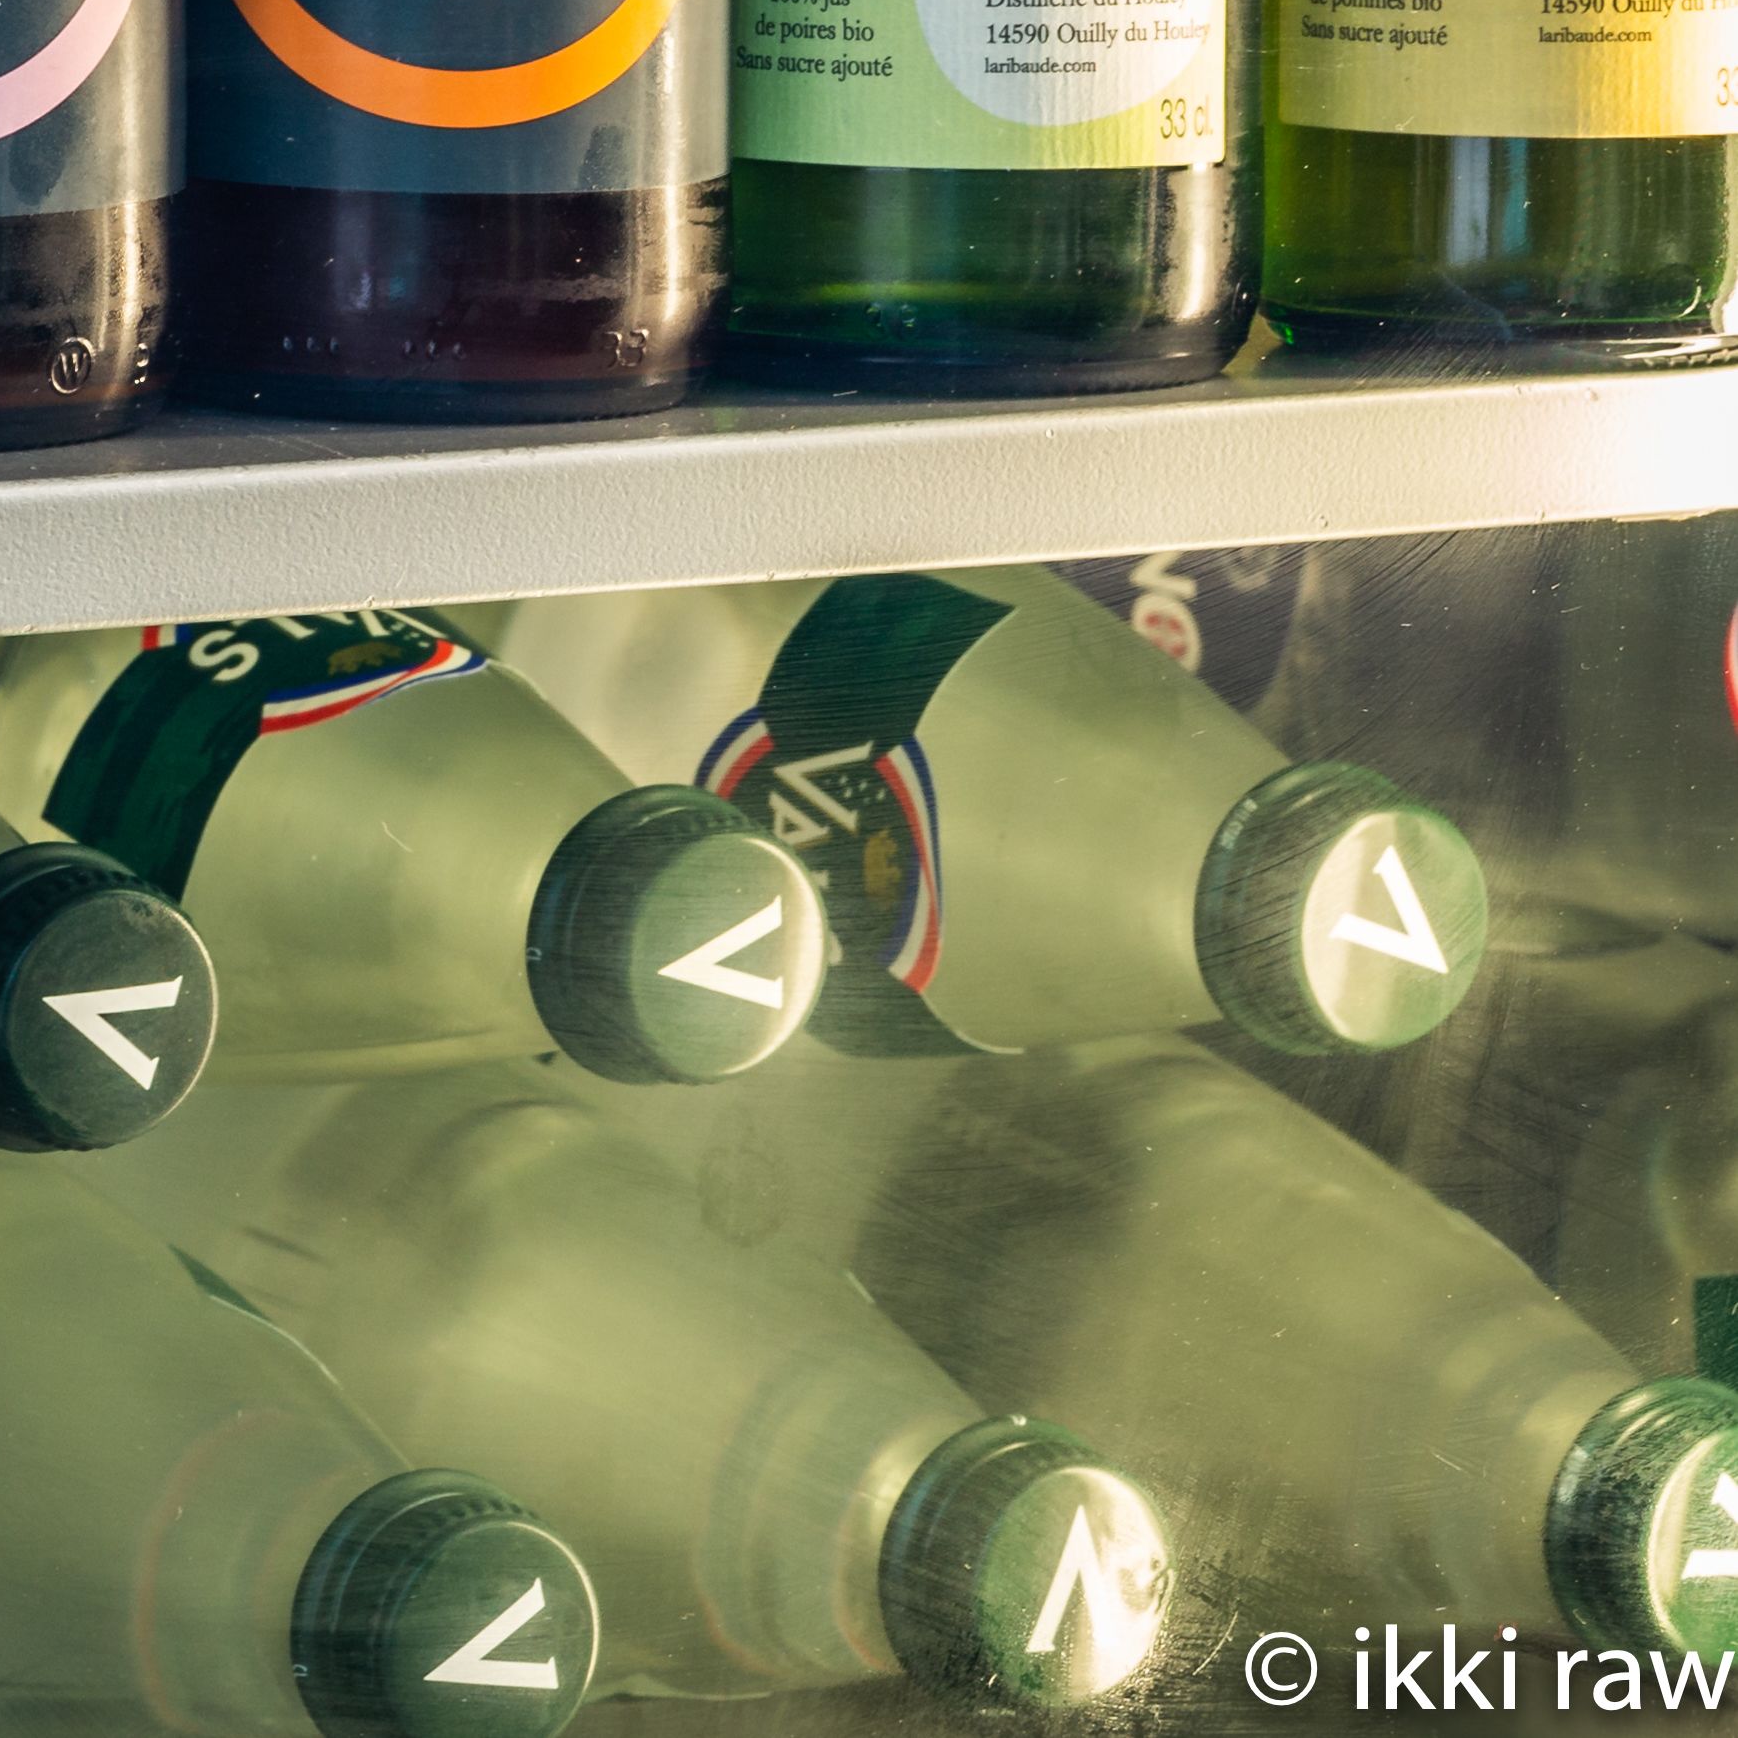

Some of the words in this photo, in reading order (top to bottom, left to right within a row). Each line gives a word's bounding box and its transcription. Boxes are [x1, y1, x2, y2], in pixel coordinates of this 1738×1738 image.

[755, 13, 776, 36] de
[780, 17, 836, 44] poires
[842, 18, 874, 41] bio
[985, 22, 1050, 45] 14590
[1057, 21, 1117, 49] Ouilly
[1124, 20, 1147, 42] du
[1301, 15, 1335, 39] Sans
[1339, 23, 1384, 43] sucre
[1389, 22, 1448, 51] ajouté
[1538, 27, 1652, 44] laribaude.com
[736, 45, 772, 71] Sans
[777, 55, 825, 73] sucre
[831, 53, 893, 82] ajouté
[984, 57, 1097, 74] laribaude.com
[1160, 98, 1188, 139] 33
[1328, 845, 1449, 974] V
[657, 895, 783, 1010] V
[42, 975, 183, 1091] V
[422, 1577, 559, 1690] V
